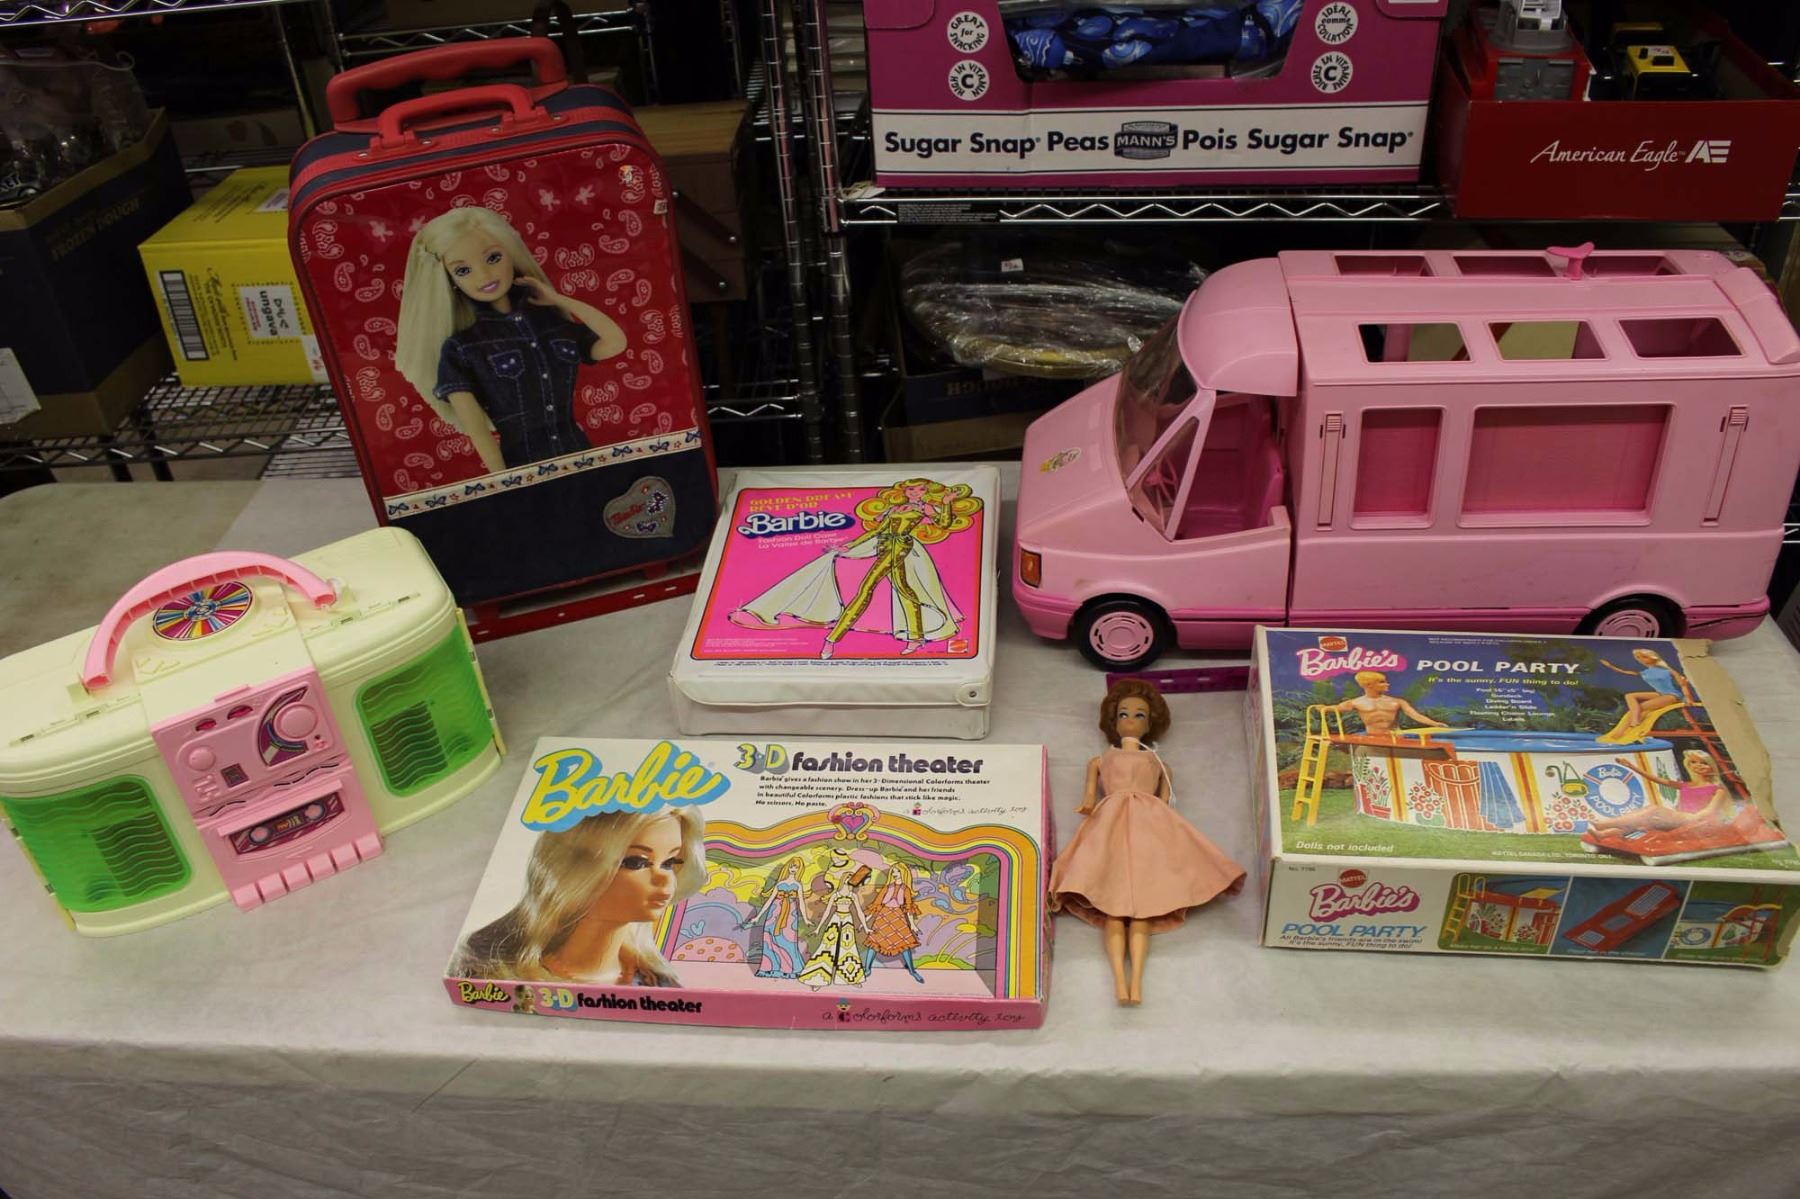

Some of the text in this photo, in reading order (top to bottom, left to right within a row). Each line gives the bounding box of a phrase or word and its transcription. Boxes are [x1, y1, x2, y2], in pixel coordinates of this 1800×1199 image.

[950, 14, 985, 30] GREAT
[961, 28, 974, 37] for
[950, 32, 985, 51] SNACKING
[950, 63, 987, 97] HIGH IN VITAMIN
[961, 74, 974, 88] C
[1324, 66, 1338, 81] C
[884, 131, 1109, 160] Sugar Snap Peas
[1116, 133, 1176, 149] MANN'S
[1182, 127, 1408, 155] Pois Sugar Snap
[1685, 140, 1732, 163] AE
[1529, 140, 1679, 172] American Eagle
[259, 290, 278, 336] ungava
[738, 511, 847, 535] Barbie
[1296, 647, 1399, 676] Barbie's
[1417, 659, 1580, 674] POOL PARTY
[1523, 679, 1548, 687] thing
[791, 751, 883, 773] fashion
[888, 753, 984, 774] theater
[521, 740, 731, 832] Barbie
[1296, 841, 1323, 850] Dolls
[1348, 844, 1395, 852] included
[1310, 882, 1420, 922] Barbie's
[1281, 923, 1428, 938] POOL PARTY
[458, 981, 510, 1003] Barbie
[577, 992, 637, 1010] fashion
[640, 993, 702, 1013] theater
